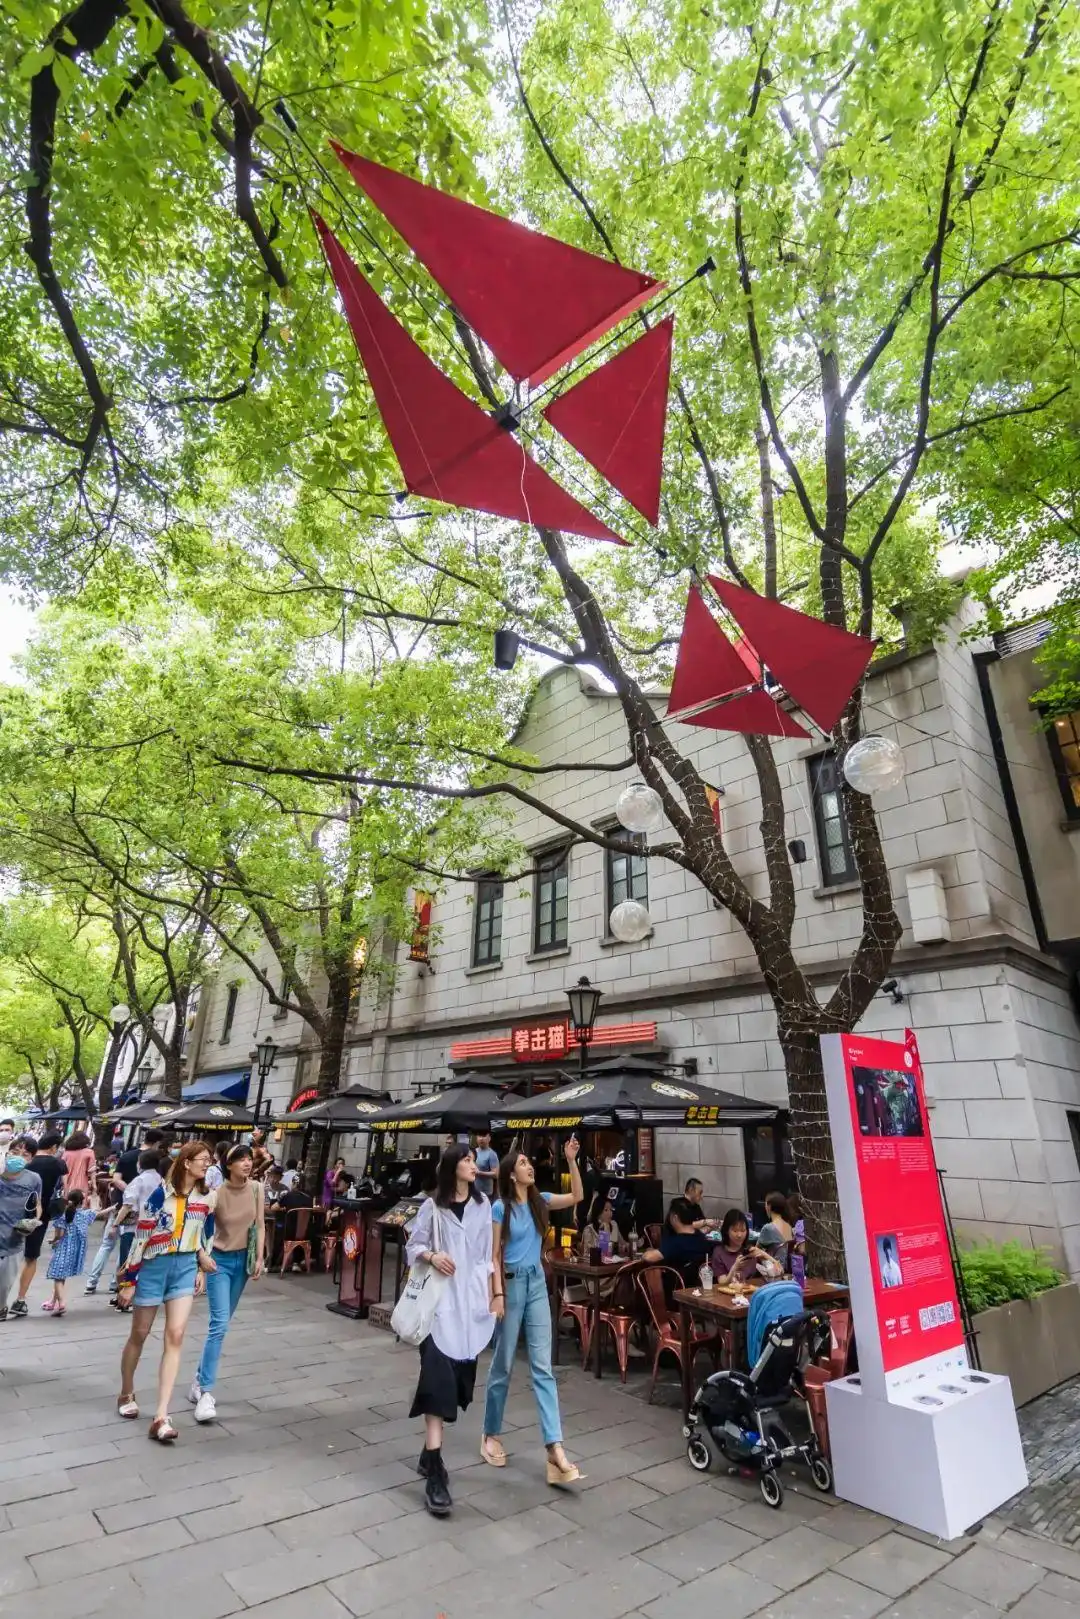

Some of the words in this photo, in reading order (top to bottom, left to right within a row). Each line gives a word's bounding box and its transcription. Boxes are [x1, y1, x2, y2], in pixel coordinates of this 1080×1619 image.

[515, 1025, 564, 1052] 拳击猫
[532, 1118, 548, 1128] CAT
